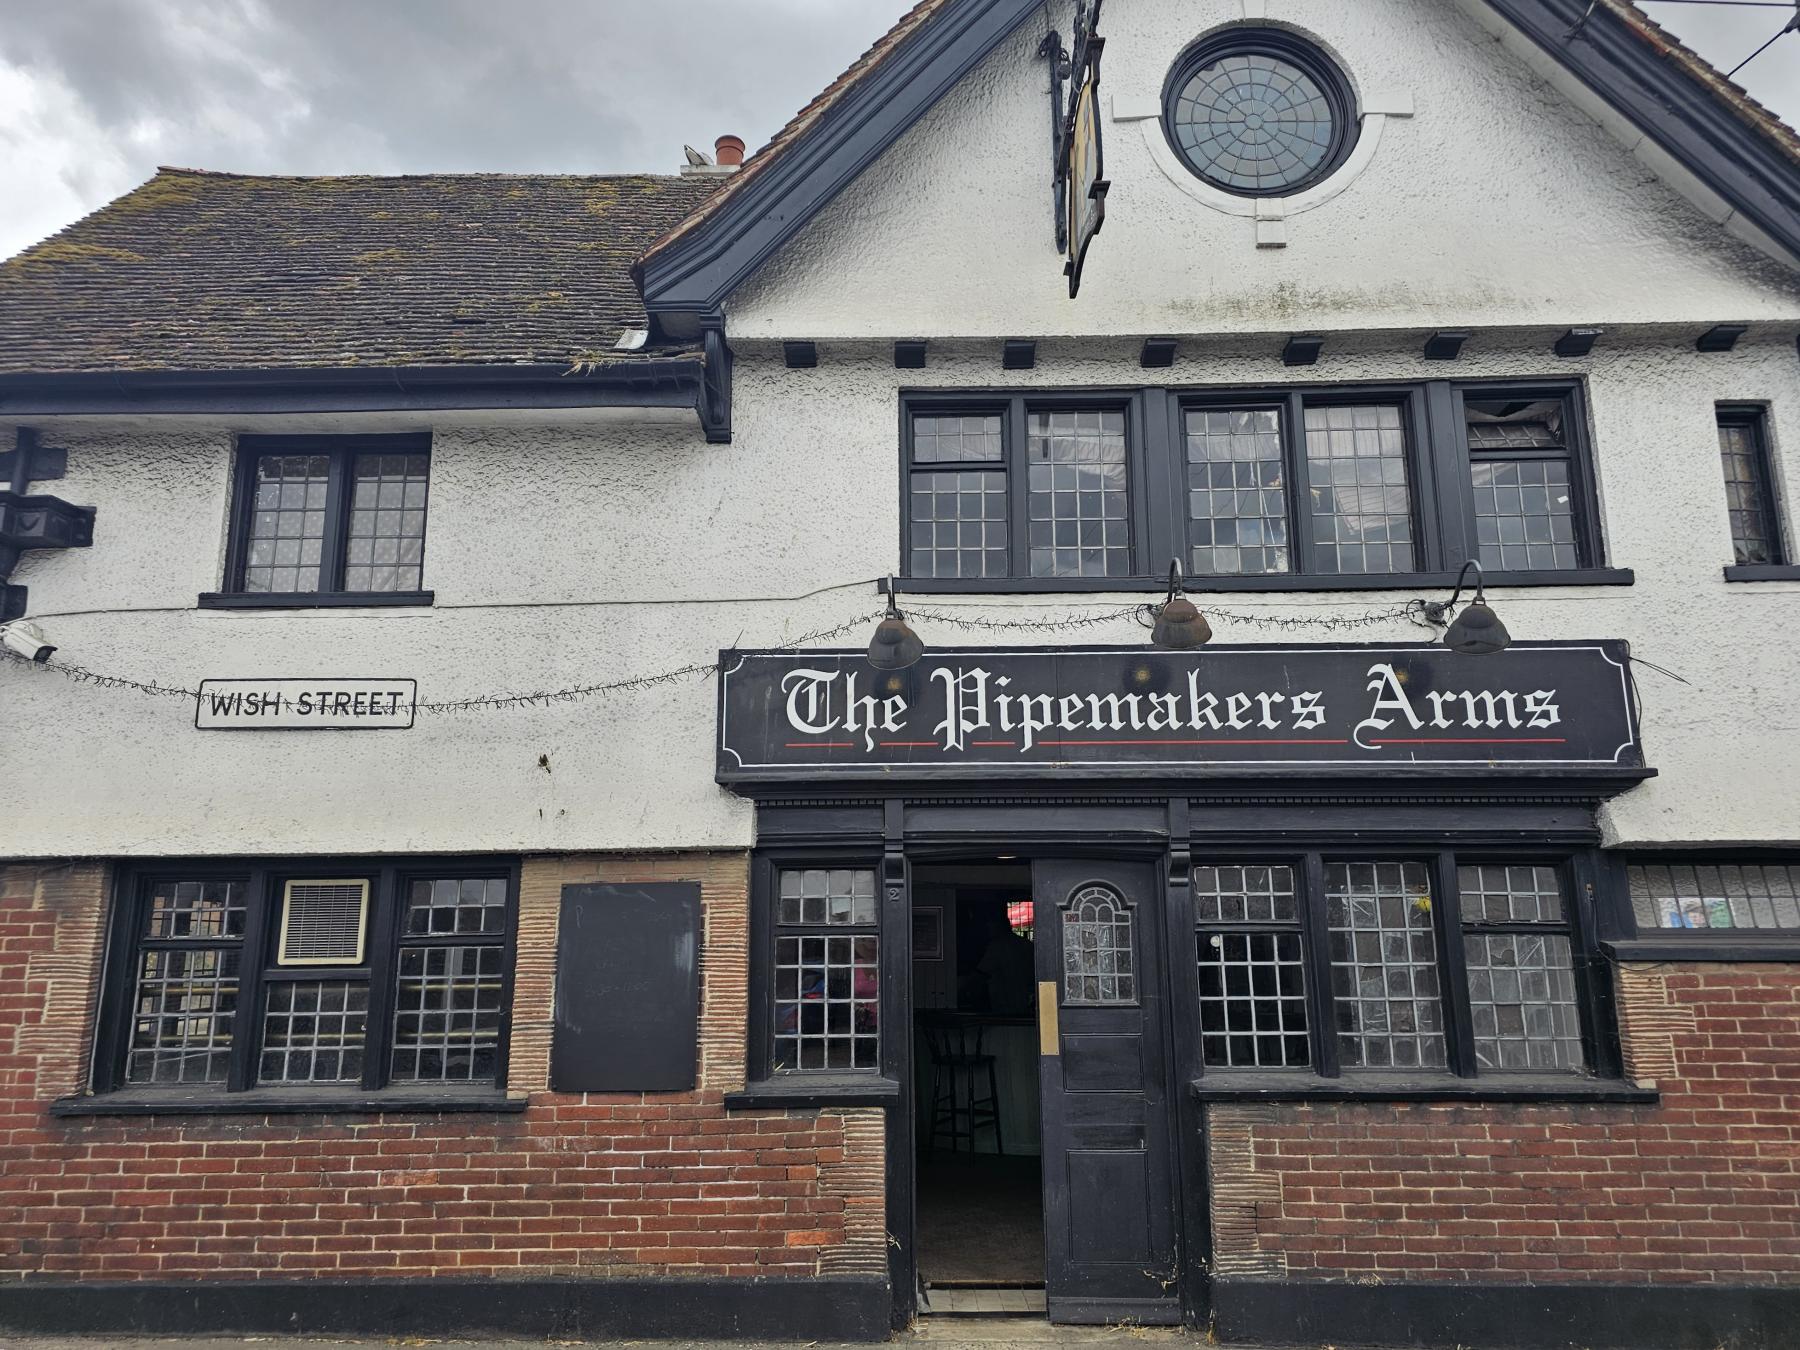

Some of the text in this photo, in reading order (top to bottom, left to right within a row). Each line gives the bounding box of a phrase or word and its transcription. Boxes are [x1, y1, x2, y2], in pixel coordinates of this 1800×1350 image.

[211, 691, 404, 716] WISH STREET
[781, 663, 1561, 752] The Pipemakers Arms
